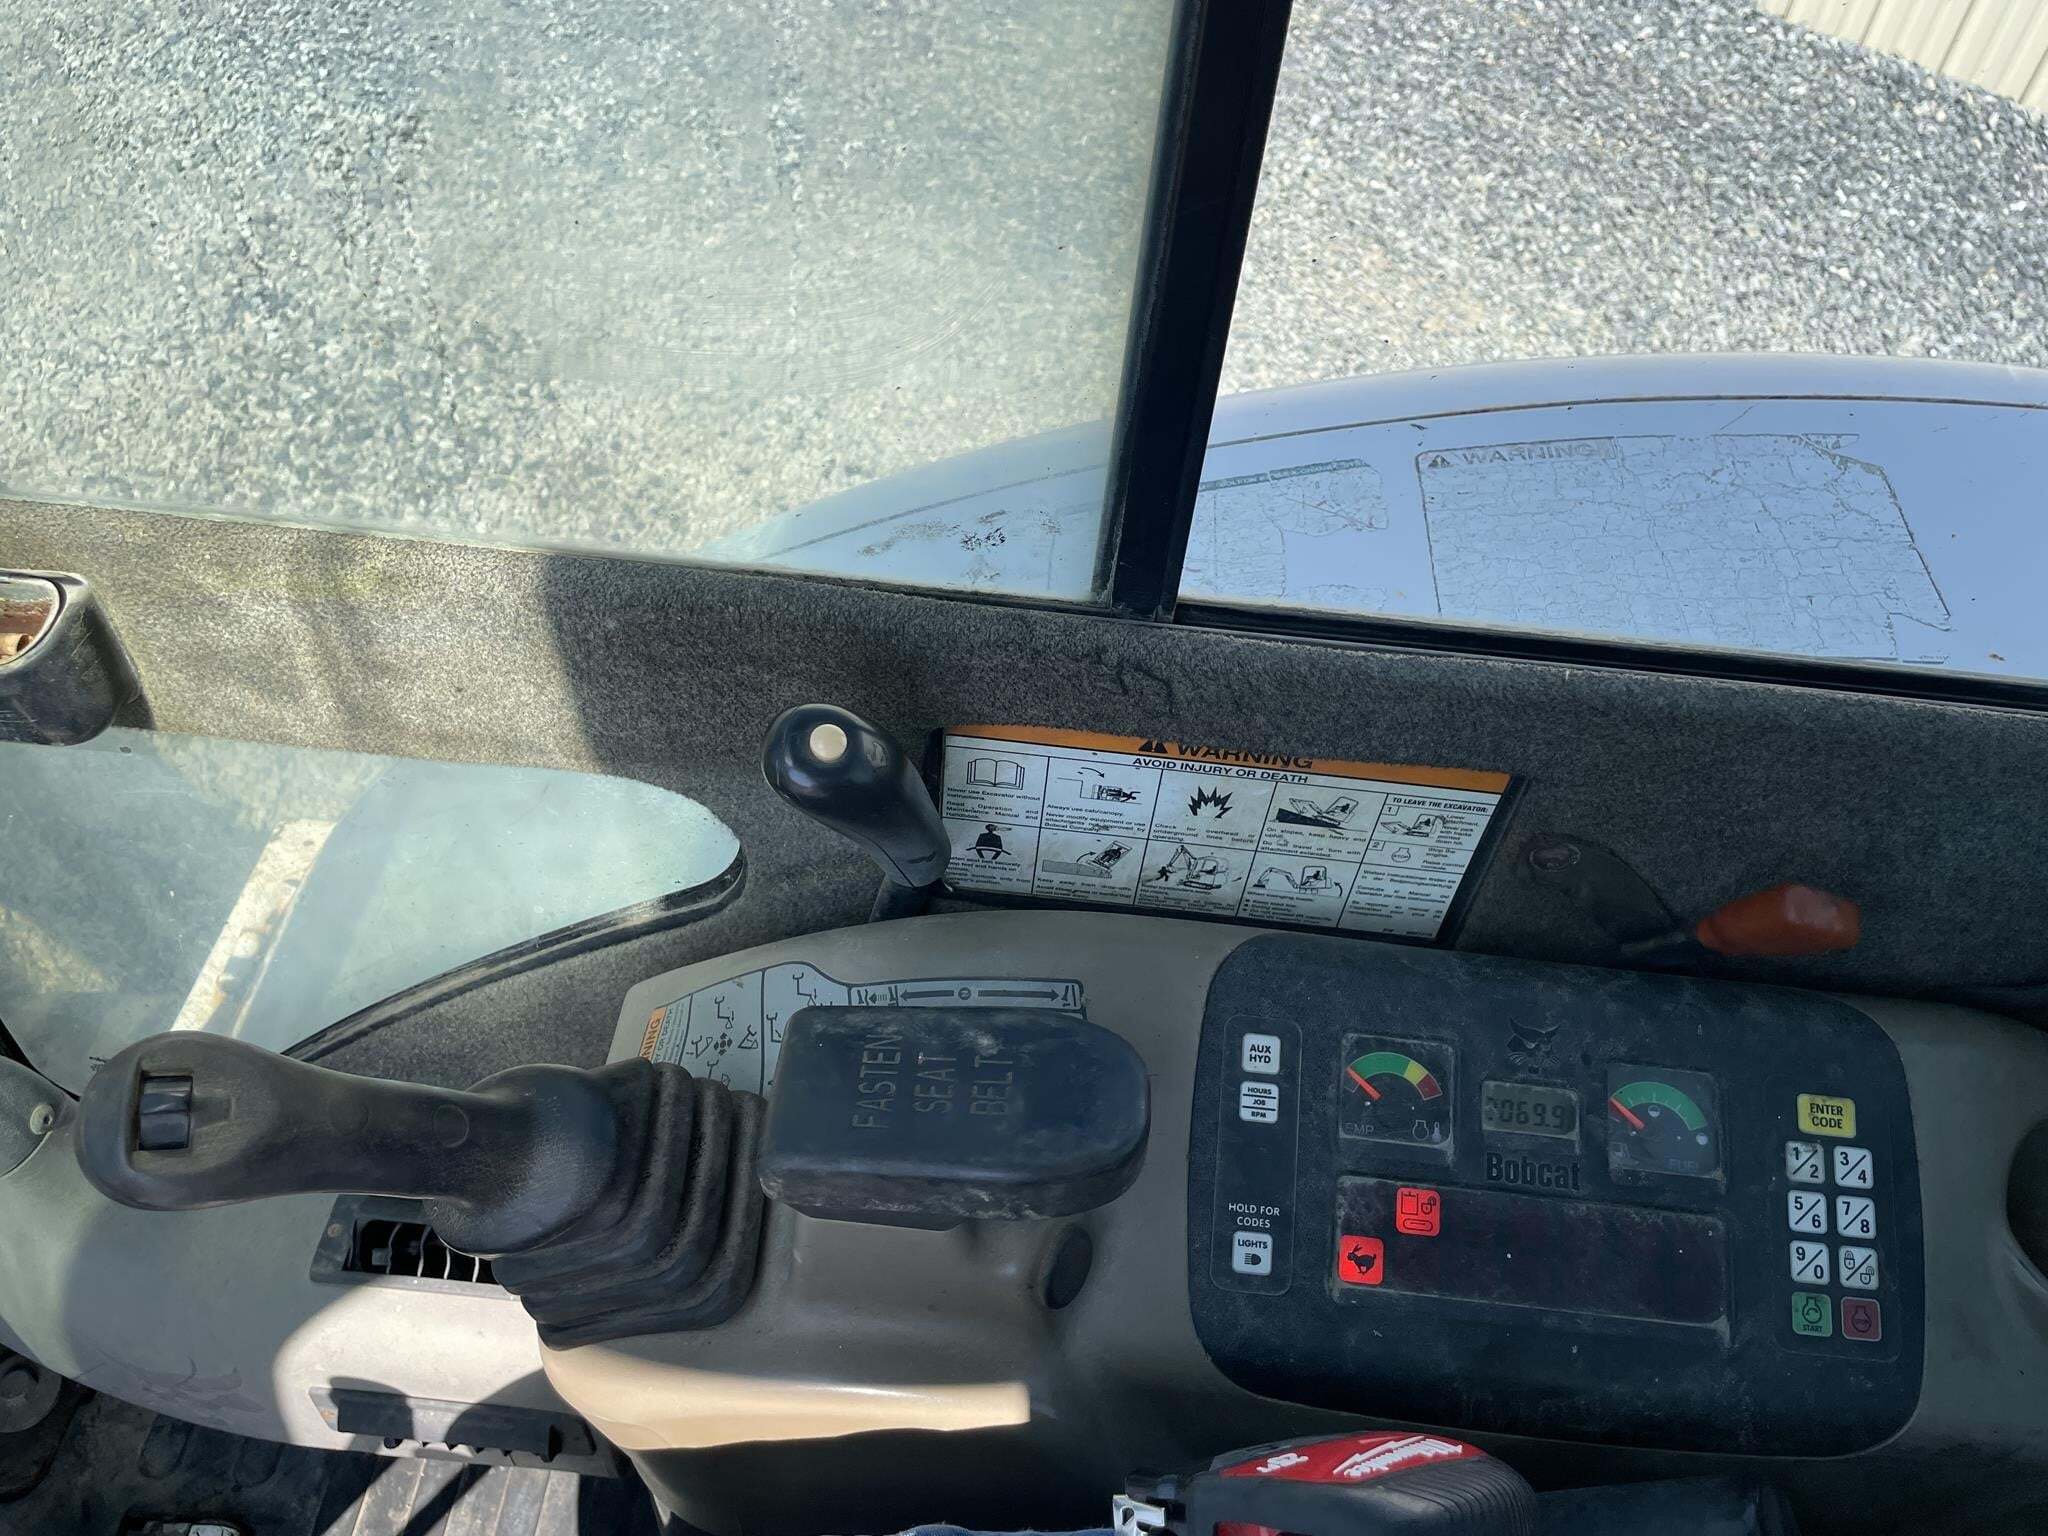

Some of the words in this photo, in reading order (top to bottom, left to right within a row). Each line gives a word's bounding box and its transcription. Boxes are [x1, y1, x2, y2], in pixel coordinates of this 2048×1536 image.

[1462, 445, 1594, 464] WARNING
[1176, 743, 1312, 769] WARNING
[1132, 757, 1177, 770] AVOID
[1179, 761, 1232, 776] INJURY
[1234, 768, 1257, 778] OR
[1259, 771, 1309, 784] DEATH
[1403, 798, 1427, 806] LEAVE
[639, 1018, 662, 1059] NING
[1249, 1043, 1272, 1055] AUX
[1249, 1053, 1271, 1064] HYD
[851, 1033, 903, 1128] FASTEN
[912, 1050, 958, 1112] SEAT
[970, 1053, 1014, 1115] BELT
[1247, 1086, 1272, 1095] HOURS
[1250, 1110, 1267, 1119] RPM
[1809, 1102, 1844, 1117] ENTER
[1811, 1116, 1844, 1129] CODE
[1486, 1151, 1579, 1191] Bobcat
[1228, 1202, 1257, 1214] HOLD
[1259, 1205, 1280, 1217] FOR
[1236, 1216, 1271, 1228] CODES
[1237, 1239, 1268, 1250] LIGHTS
[1801, 1323, 1823, 1333] START
